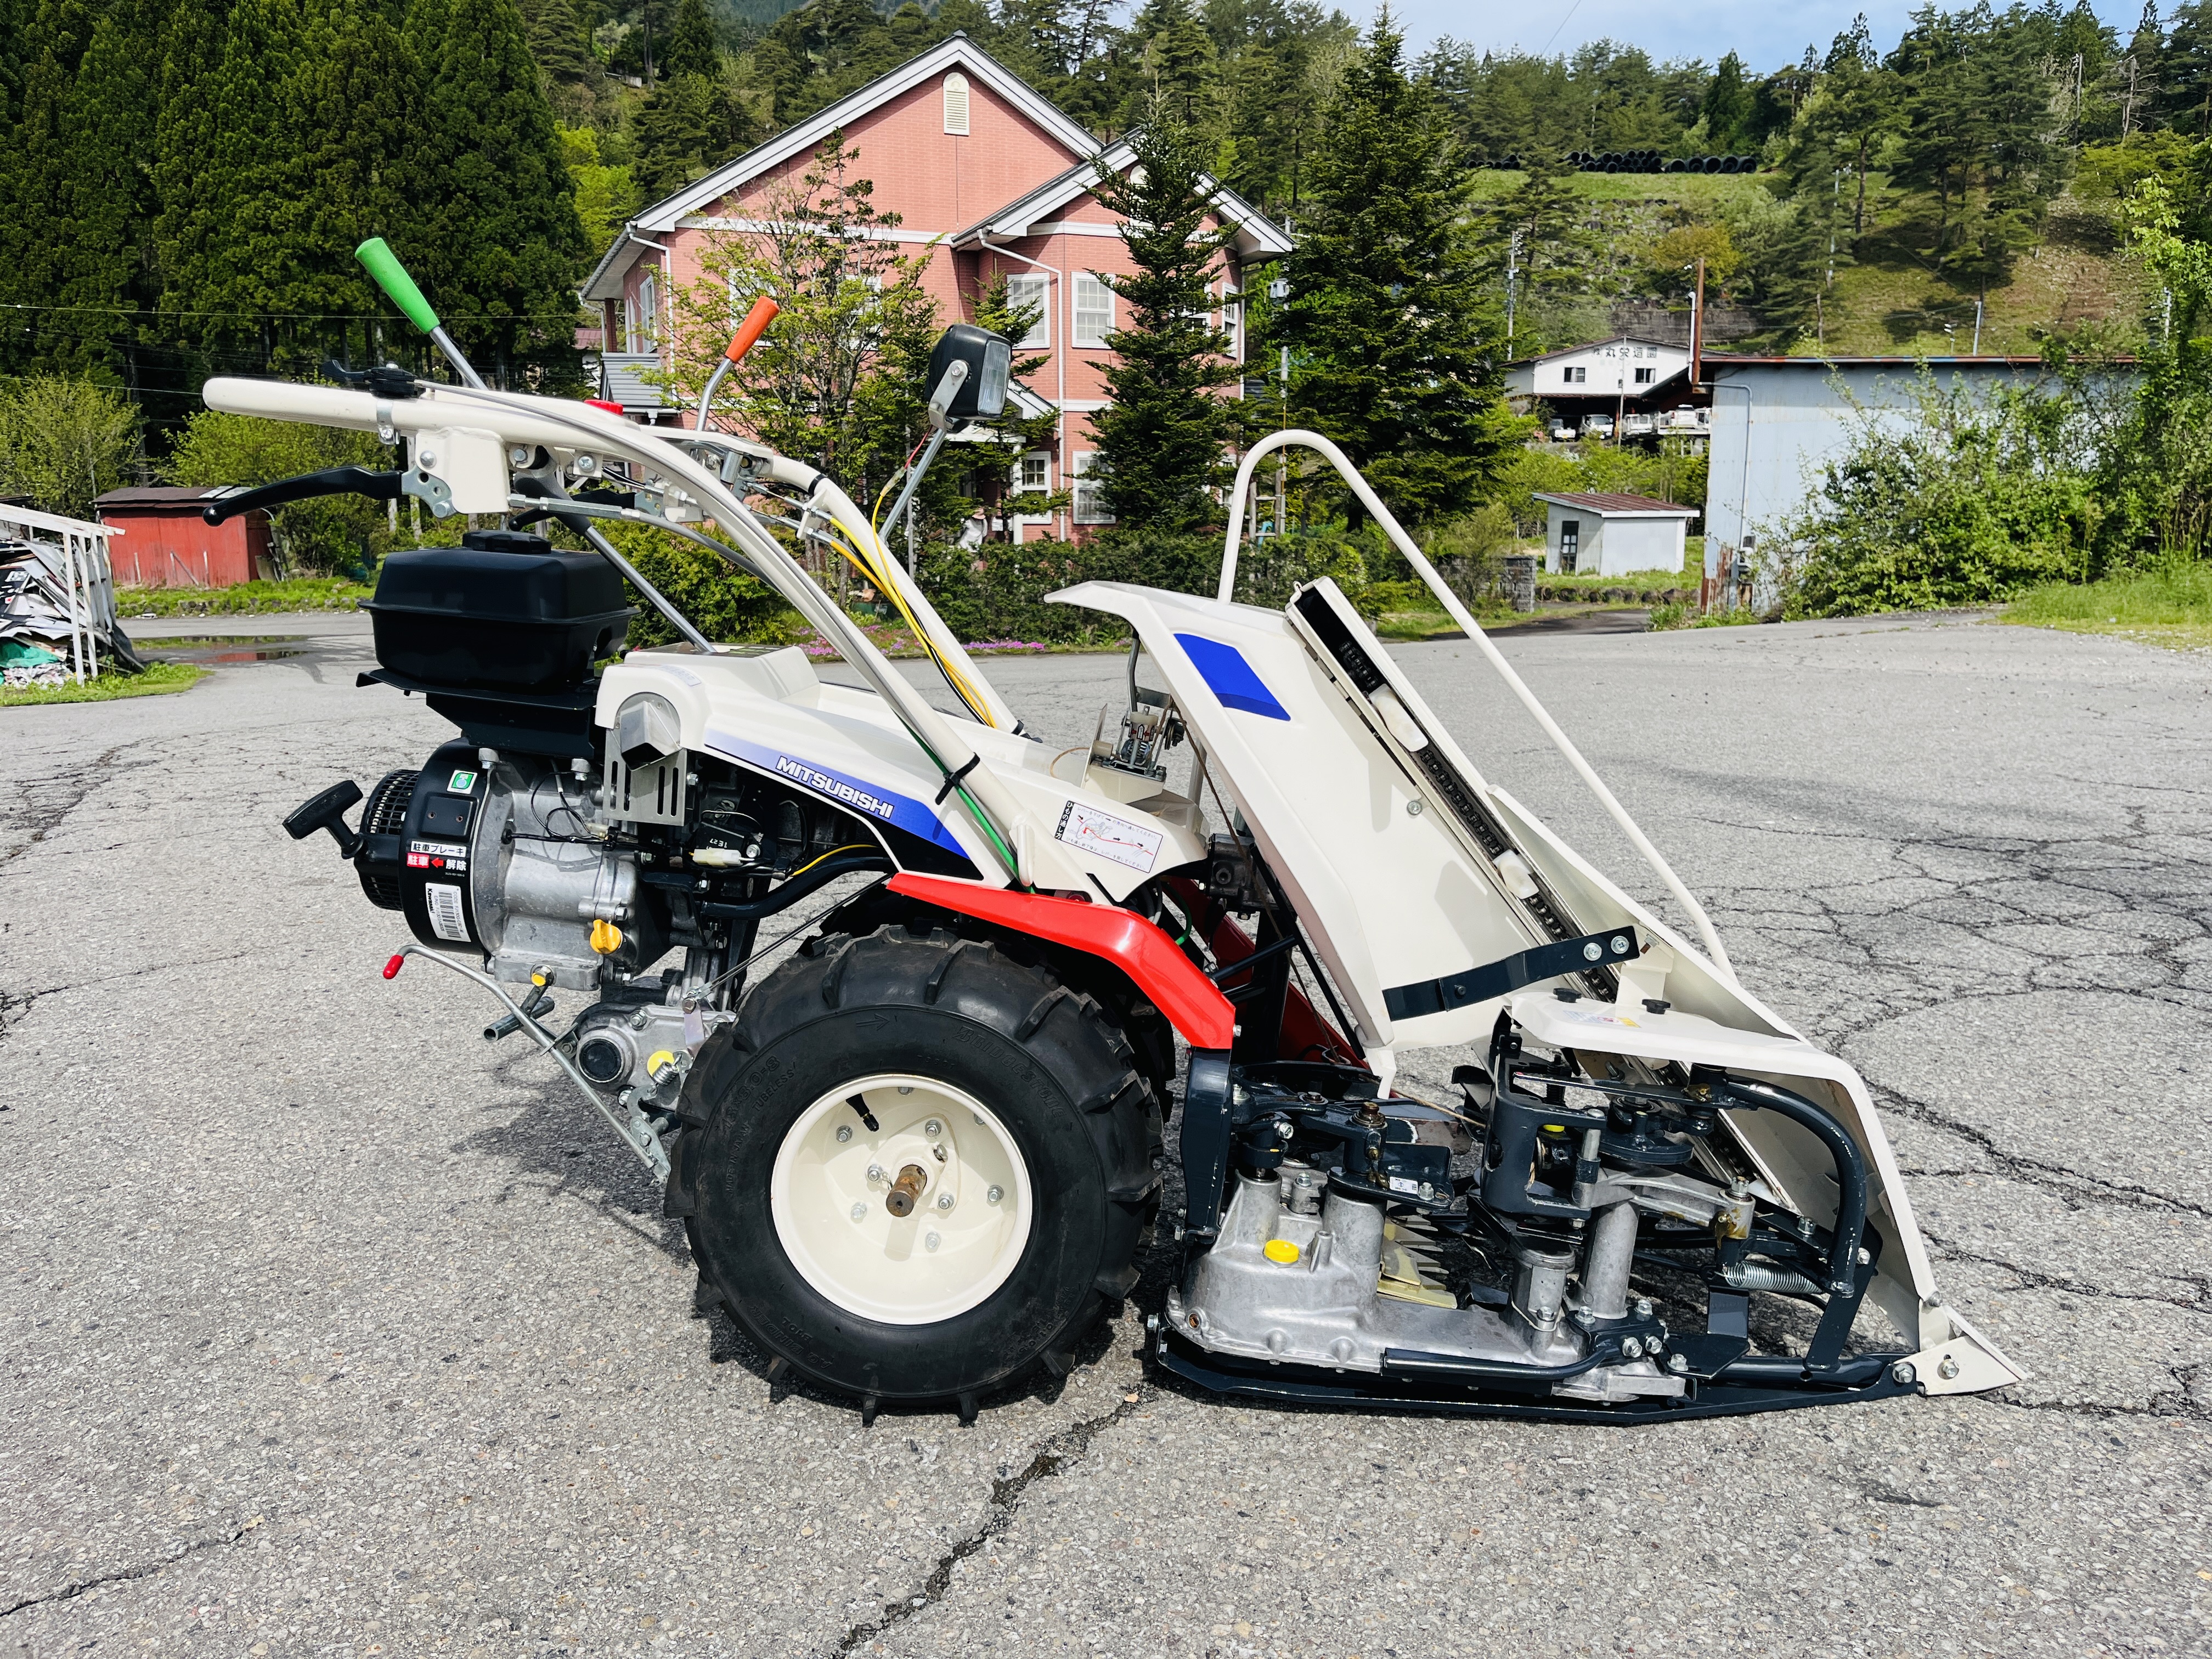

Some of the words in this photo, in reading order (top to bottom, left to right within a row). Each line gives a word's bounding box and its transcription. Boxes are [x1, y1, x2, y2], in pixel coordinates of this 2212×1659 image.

[775, 755, 895, 820] MITSUBISHI
[1055, 802, 1073, 839] ひもの通し方
[407, 854, 428, 867] 駐車
[445, 859, 467, 871] 解除
[413, 843, 464, 856] 駐車ブレーキ
[427, 888, 436, 914] Kawasaki
[952, 1025, 1067, 1118] BRIDGESTONE
[752, 1069, 794, 1111] TUBELESS
[729, 1153, 738, 1164] IN
[724, 1167, 735, 1194] MADE
[749, 1306, 804, 1355] BINDER
[807, 1352, 833, 1369] AG
